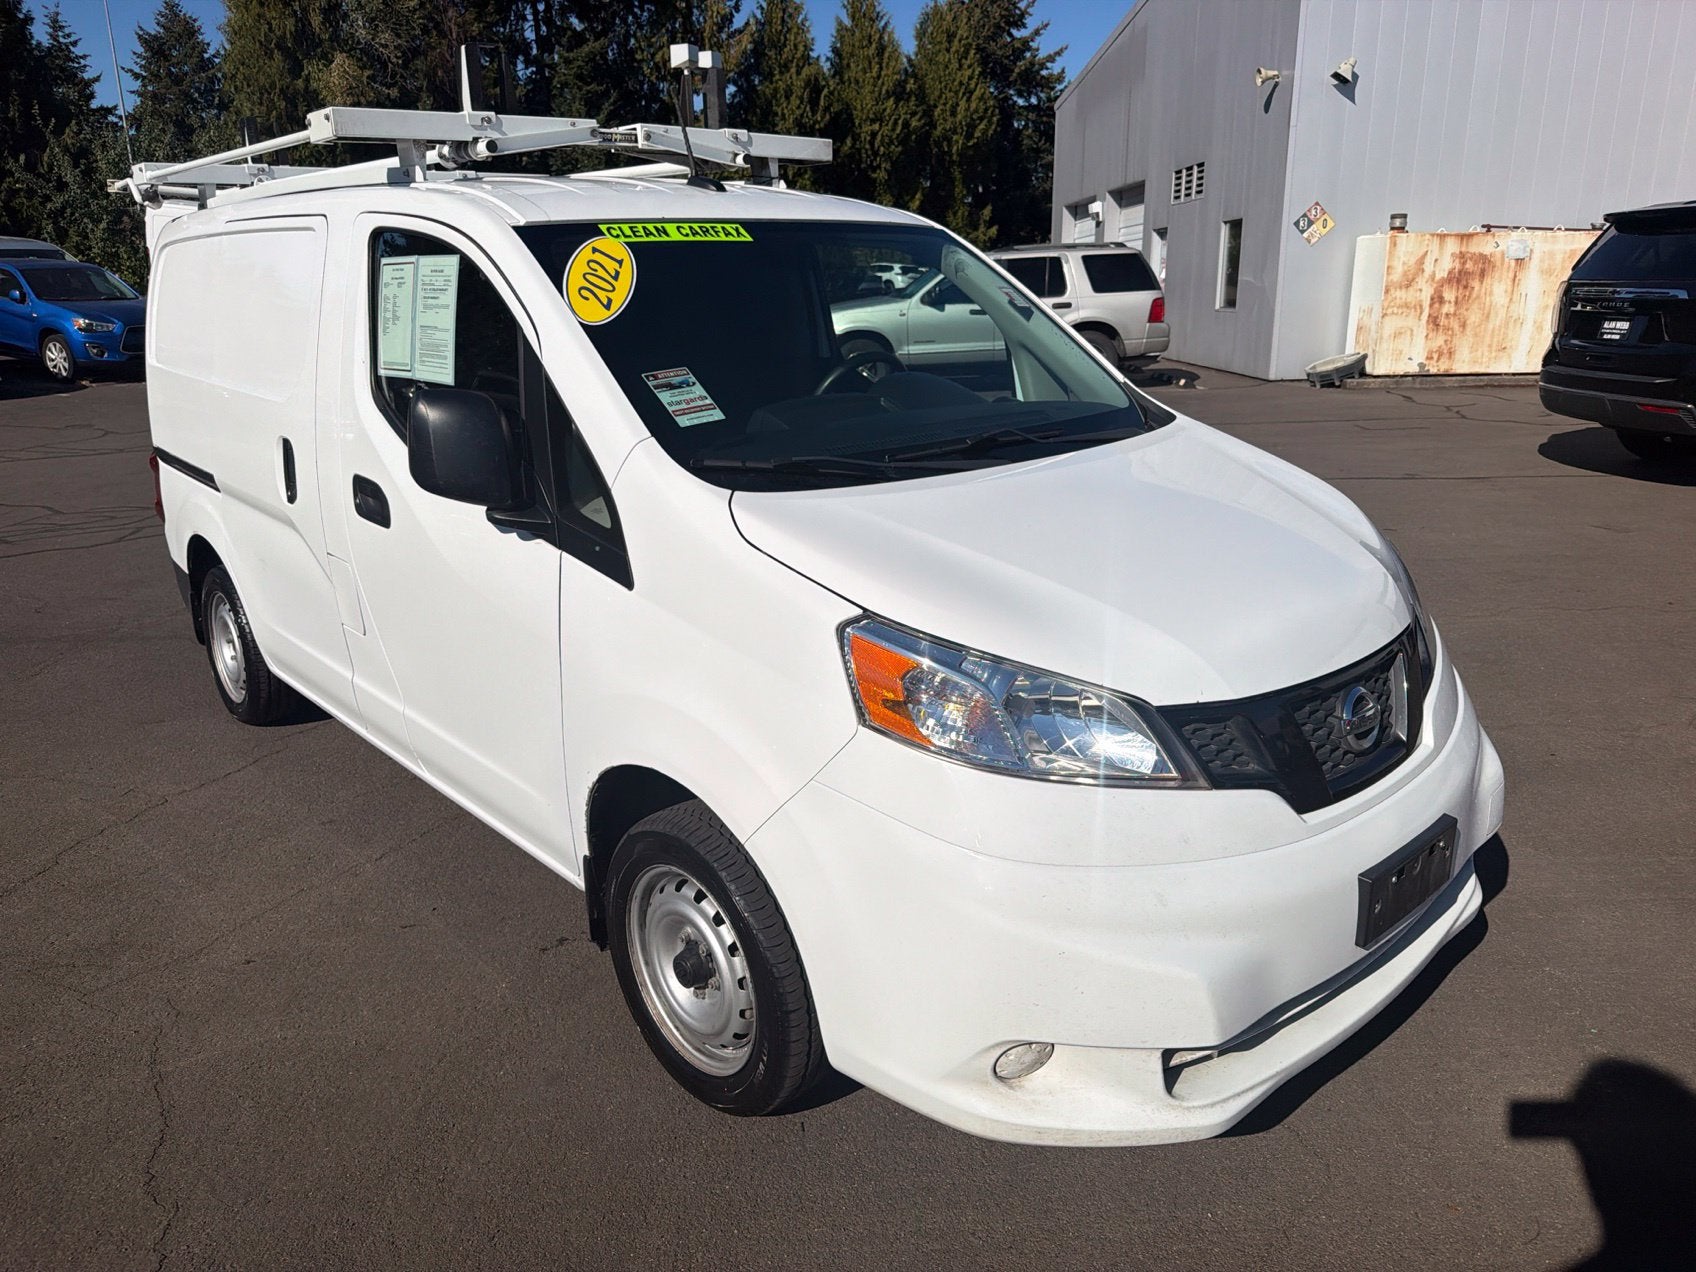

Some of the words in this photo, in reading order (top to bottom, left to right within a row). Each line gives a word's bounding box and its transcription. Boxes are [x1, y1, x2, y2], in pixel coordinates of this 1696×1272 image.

[1313, 207, 1318, 217] 3
[1301, 219, 1306, 229] 3
[1322, 218, 1328, 229] 0
[606, 225, 673, 240] CLEAN
[676, 225, 750, 239] CARFAX
[577, 246, 625, 312] 2021
[658, 370, 687, 378] ATTENTION
